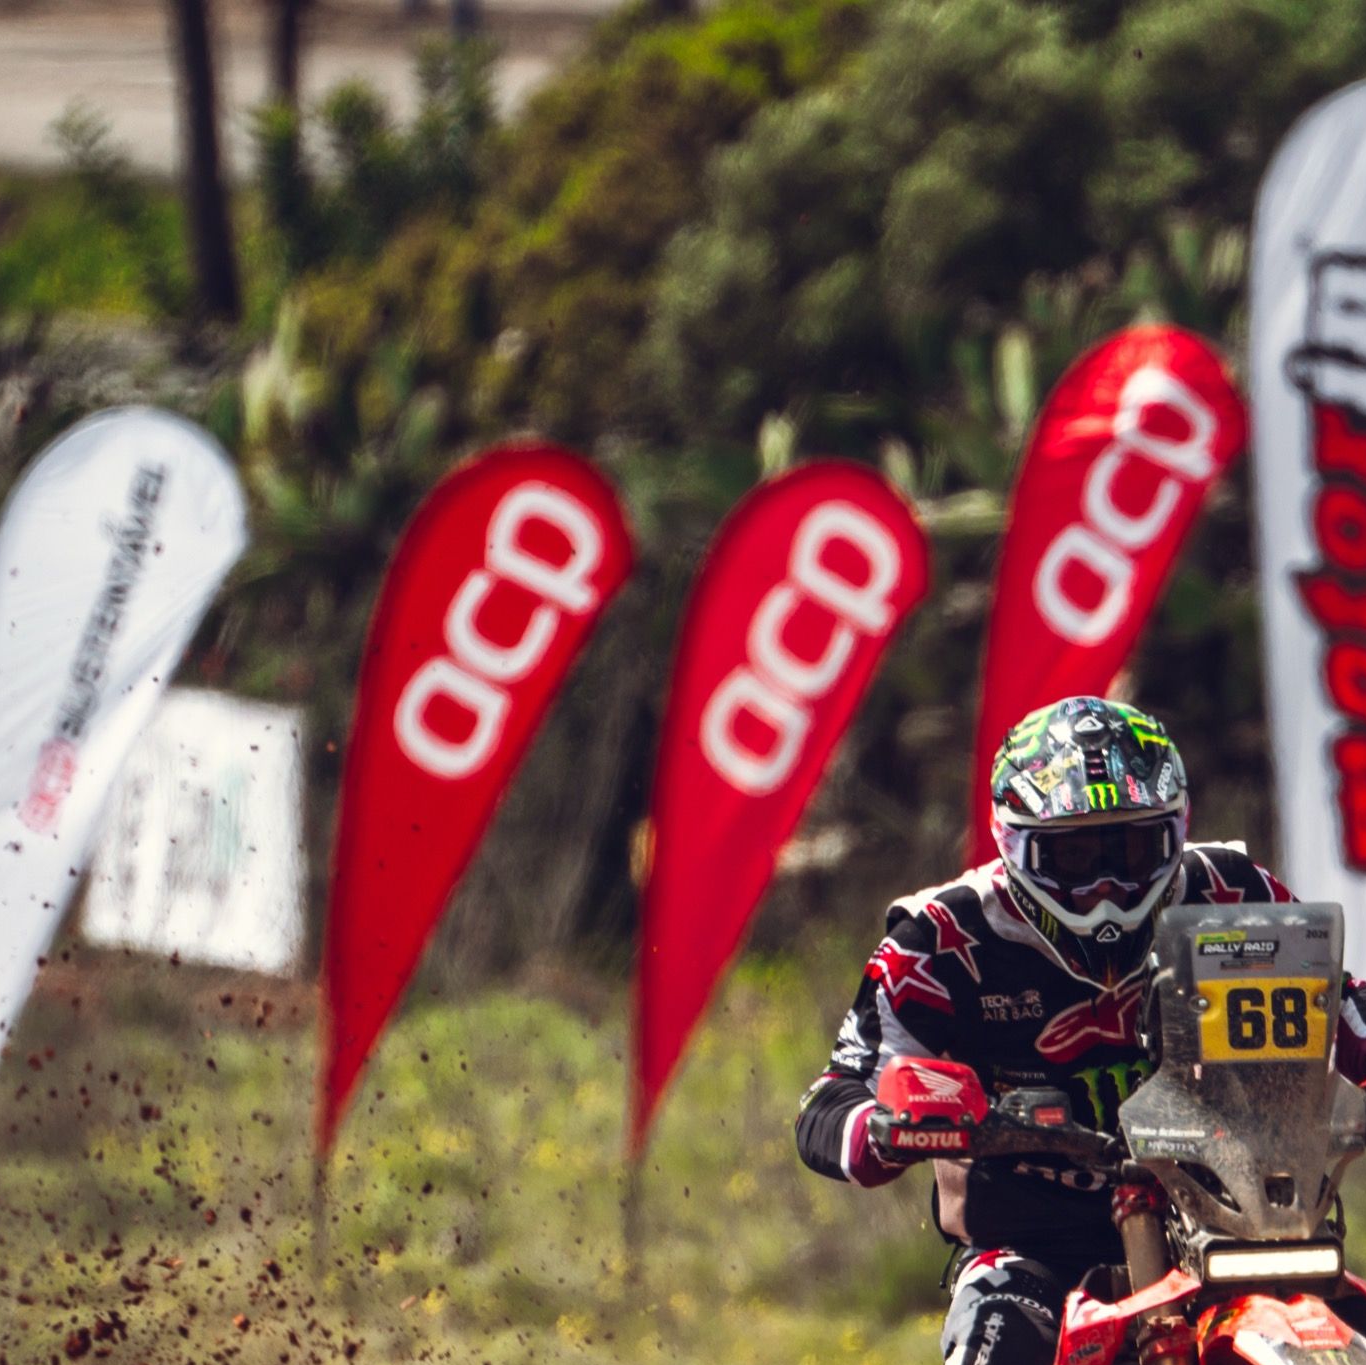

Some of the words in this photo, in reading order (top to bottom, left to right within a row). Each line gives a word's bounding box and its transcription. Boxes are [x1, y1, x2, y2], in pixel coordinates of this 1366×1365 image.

[394, 481, 604, 780] acp
[700, 500, 900, 796] acp
[1203, 943, 1241, 954] RALLY
[1243, 941, 1275, 952] RAID
[983, 1007, 1008, 1022] AIR
[1011, 1003, 1044, 1020] BAG
[1226, 986, 1308, 1050] 68
[908, 1094, 963, 1105] HONDA
[897, 1130, 963, 1148] MOTUL
